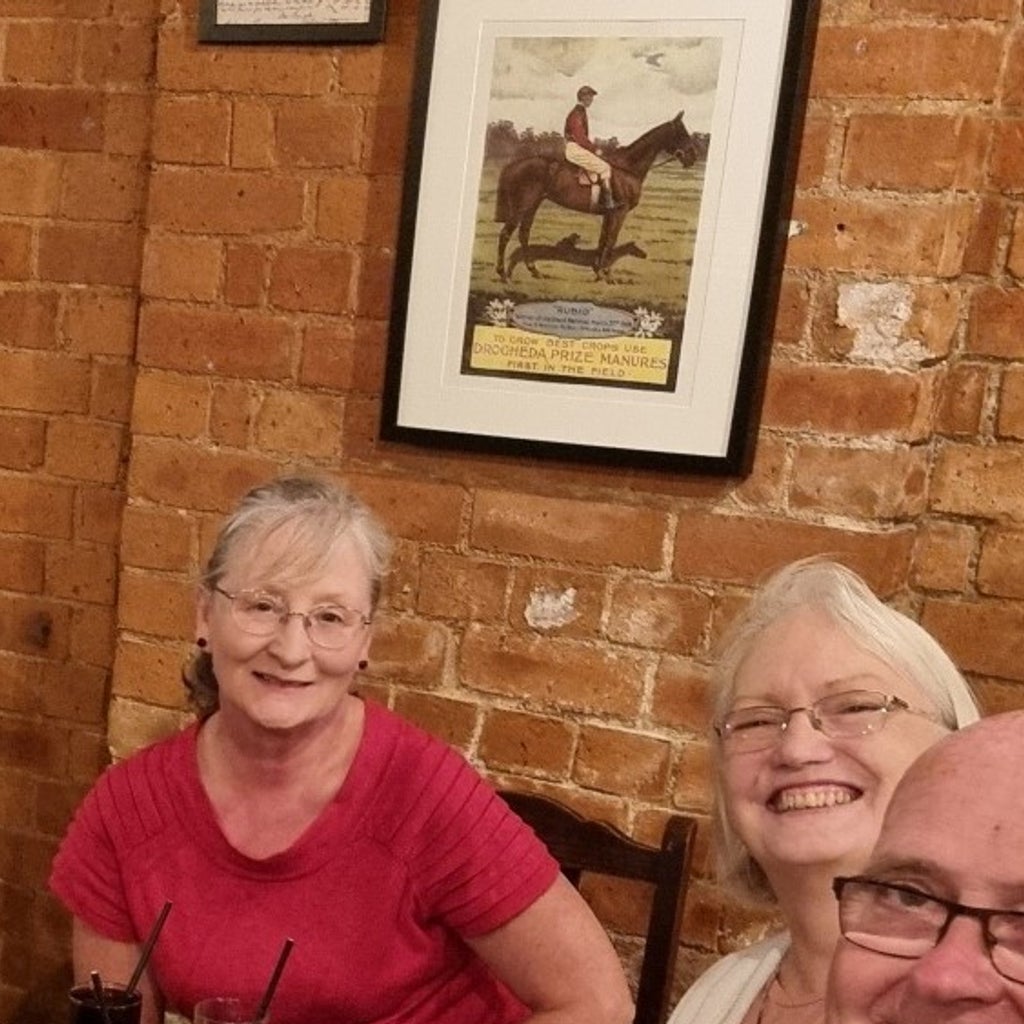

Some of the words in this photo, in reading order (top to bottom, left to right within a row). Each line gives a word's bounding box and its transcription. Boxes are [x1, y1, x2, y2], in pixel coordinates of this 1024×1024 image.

[474, 342, 547, 359] DROGHEDA
[550, 349, 594, 364] PRIZE
[600, 352, 667, 369] MANURES
[562, 365, 585, 375] THE
